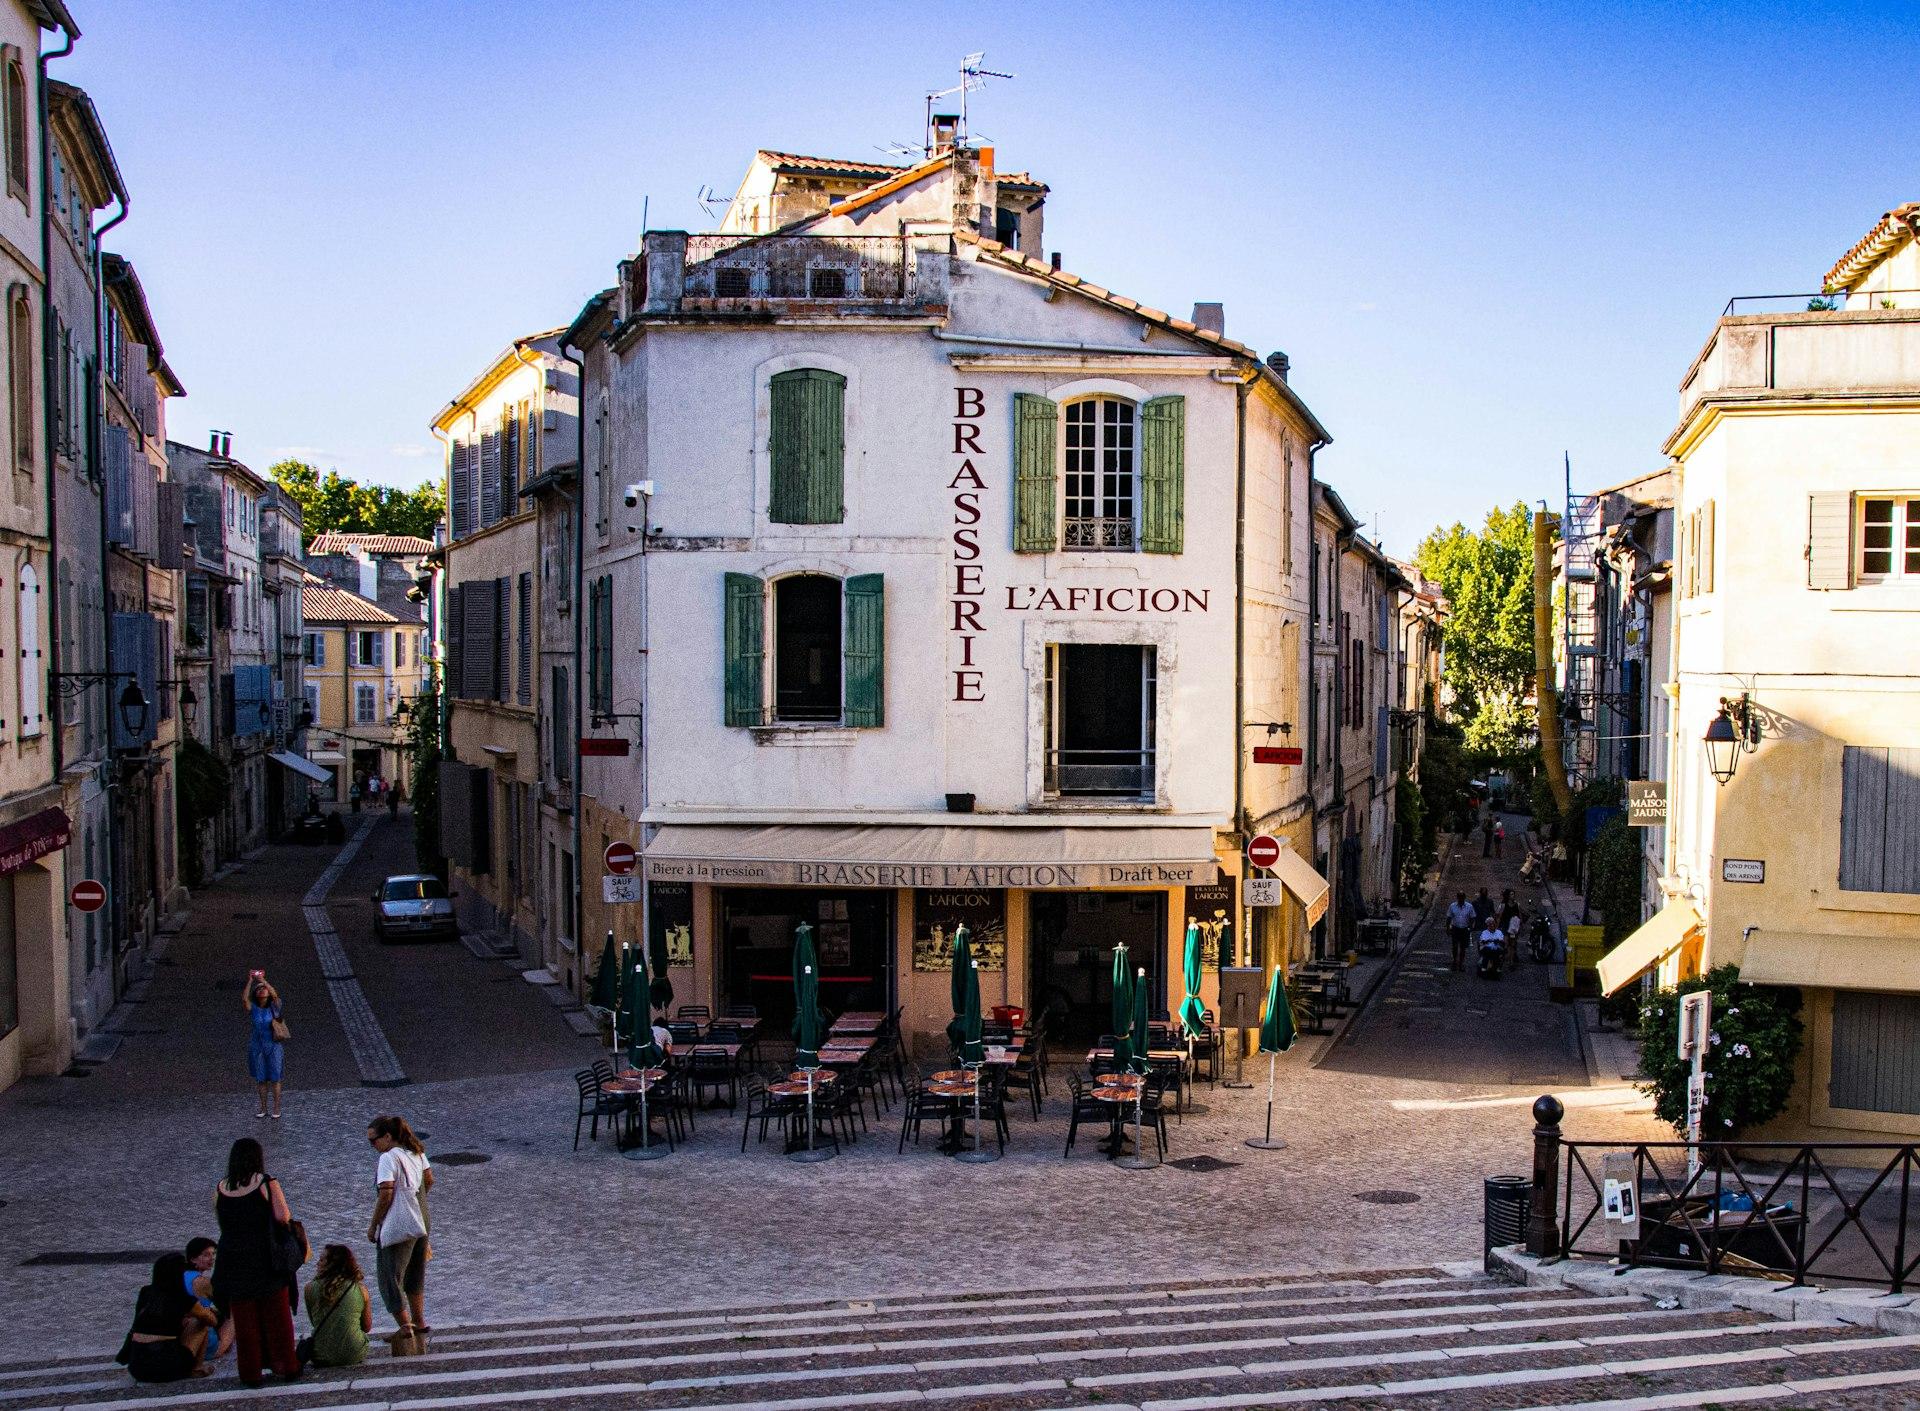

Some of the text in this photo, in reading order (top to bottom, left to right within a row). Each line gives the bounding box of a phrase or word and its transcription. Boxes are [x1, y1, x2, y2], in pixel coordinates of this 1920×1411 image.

[947, 387, 989, 702] BRASSERIE
[1005, 586, 1211, 612] L'AFICION
[1643, 789, 1658, 798] LA
[687, 864, 694, 875] à
[698, 864, 708, 875] la
[711, 865, 765, 879] pression
[799, 864, 1076, 886] BRASSERIE L'AFICION
[1110, 866, 1193, 881] Draft beer
[612, 878, 632, 886] SAUF
[1252, 881, 1272, 889] SAUF
[929, 894, 991, 907] L'AFICION
